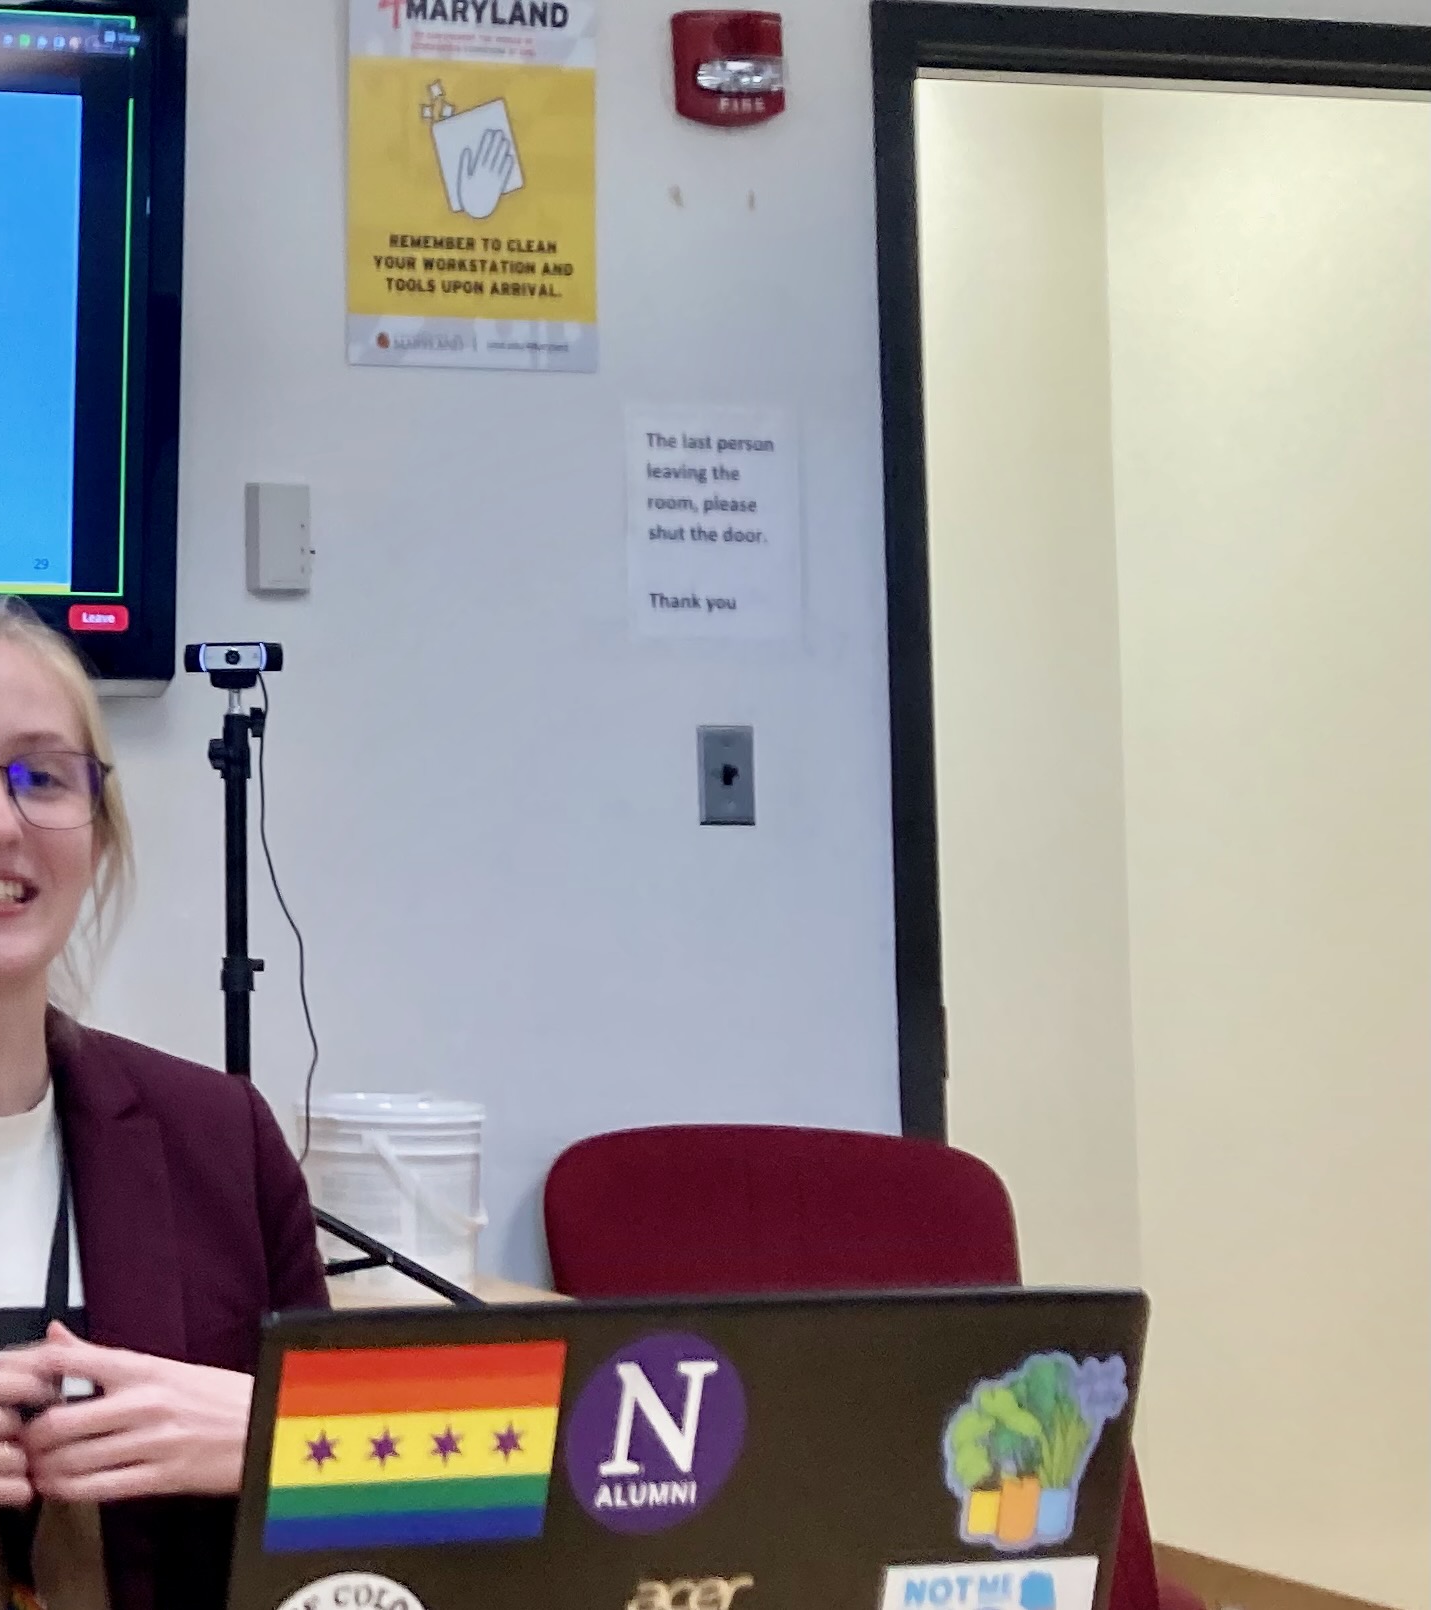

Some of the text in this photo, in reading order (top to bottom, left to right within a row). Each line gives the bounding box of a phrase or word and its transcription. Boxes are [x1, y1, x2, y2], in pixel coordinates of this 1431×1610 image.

[406, 0, 569, 28] MARYLAND
[389, 234, 558, 254] REMEMBER TO CLEAN
[373, 255, 574, 276] YOUR WORKSTATION AND
[386, 277, 563, 298] TOOLS UPON ARRIVAL.
[646, 432, 775, 453] The last person
[646, 461, 741, 484] leaving the
[647, 493, 758, 514] room, please
[648, 523, 768, 543] shut the door.
[33, 558, 50, 570] 29
[648, 592, 737, 612] Thank you
[81, 611, 116, 624] Leave
[598, 1360, 718, 1477] N
[594, 1479, 698, 1510] ALUMNI
[624, 1572, 755, 1610] acer
[904, 1574, 973, 1606] NOT
